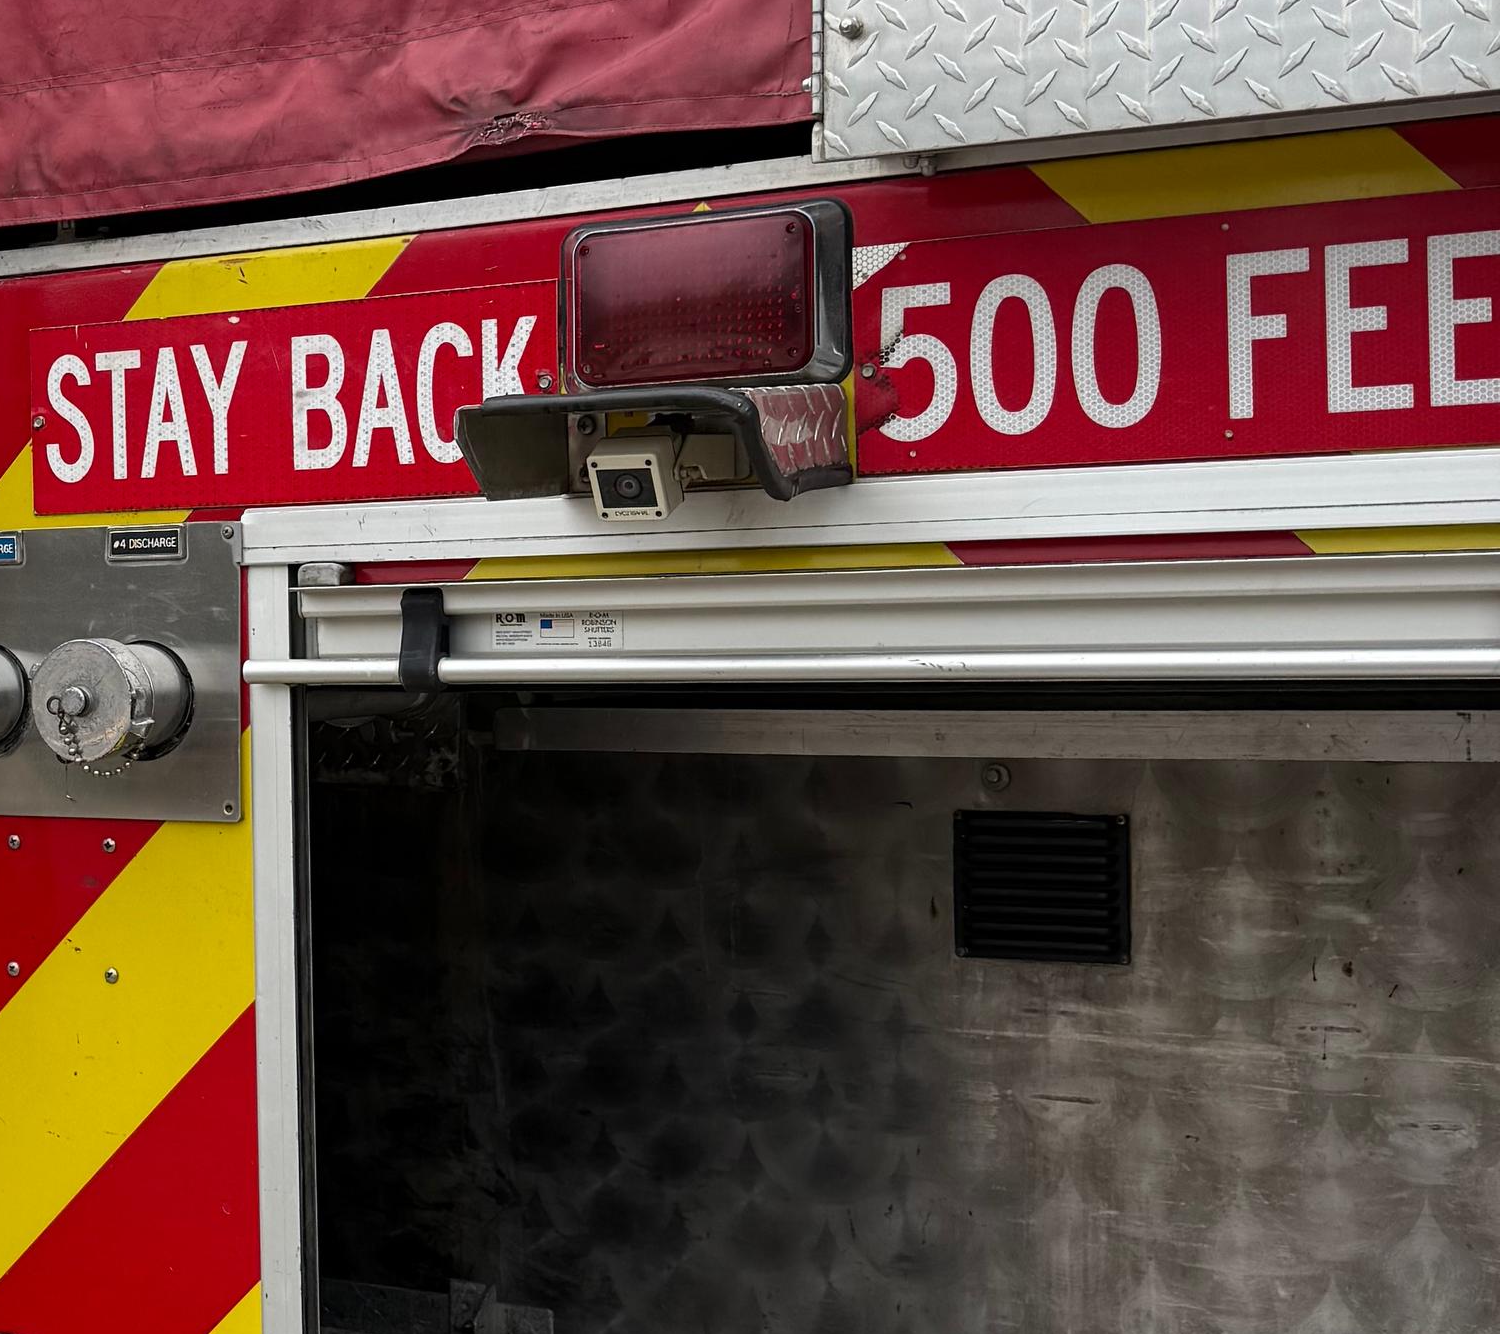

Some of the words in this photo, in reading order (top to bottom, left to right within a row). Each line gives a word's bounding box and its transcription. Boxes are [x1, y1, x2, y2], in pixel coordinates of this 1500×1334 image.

[46, 341, 248, 484] STAY
[291, 315, 538, 471] BACK
[879, 264, 1162, 442] 500
[113, 539, 127, 549] #4
[128, 536, 177, 549] DISCHARGE
